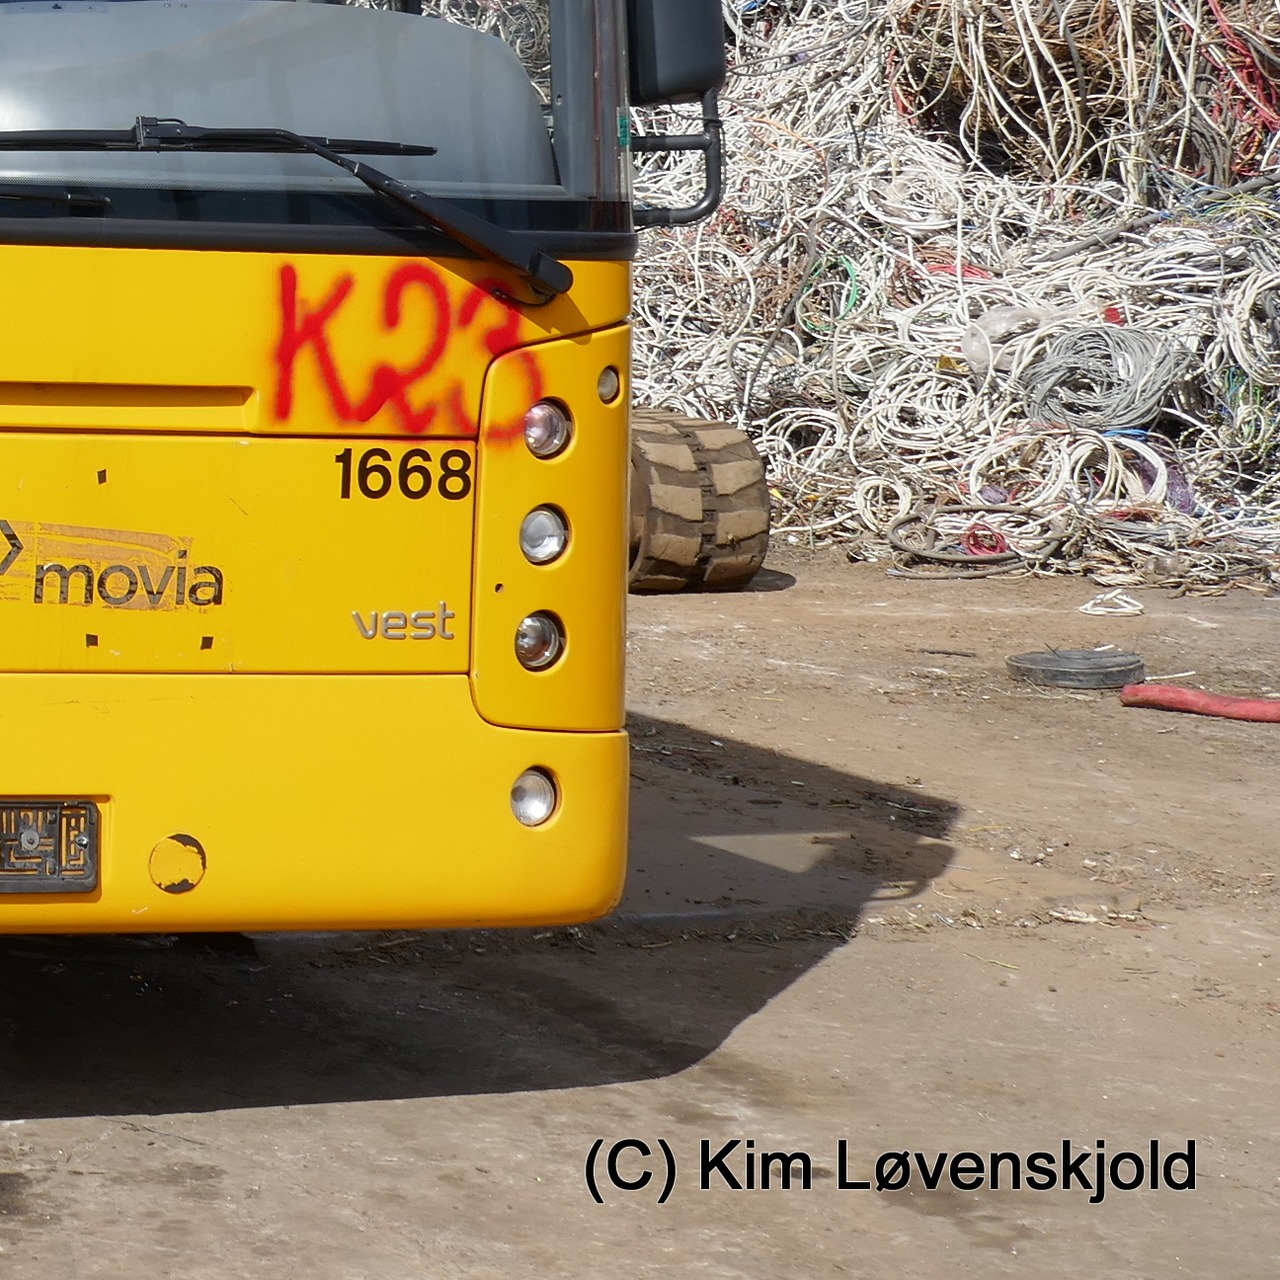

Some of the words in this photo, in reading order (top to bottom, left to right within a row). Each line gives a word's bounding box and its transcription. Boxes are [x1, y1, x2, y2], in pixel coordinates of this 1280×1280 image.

[334, 447, 472, 500] 1668
[33, 549, 224, 607] movia
[351, 601, 456, 640] vest
